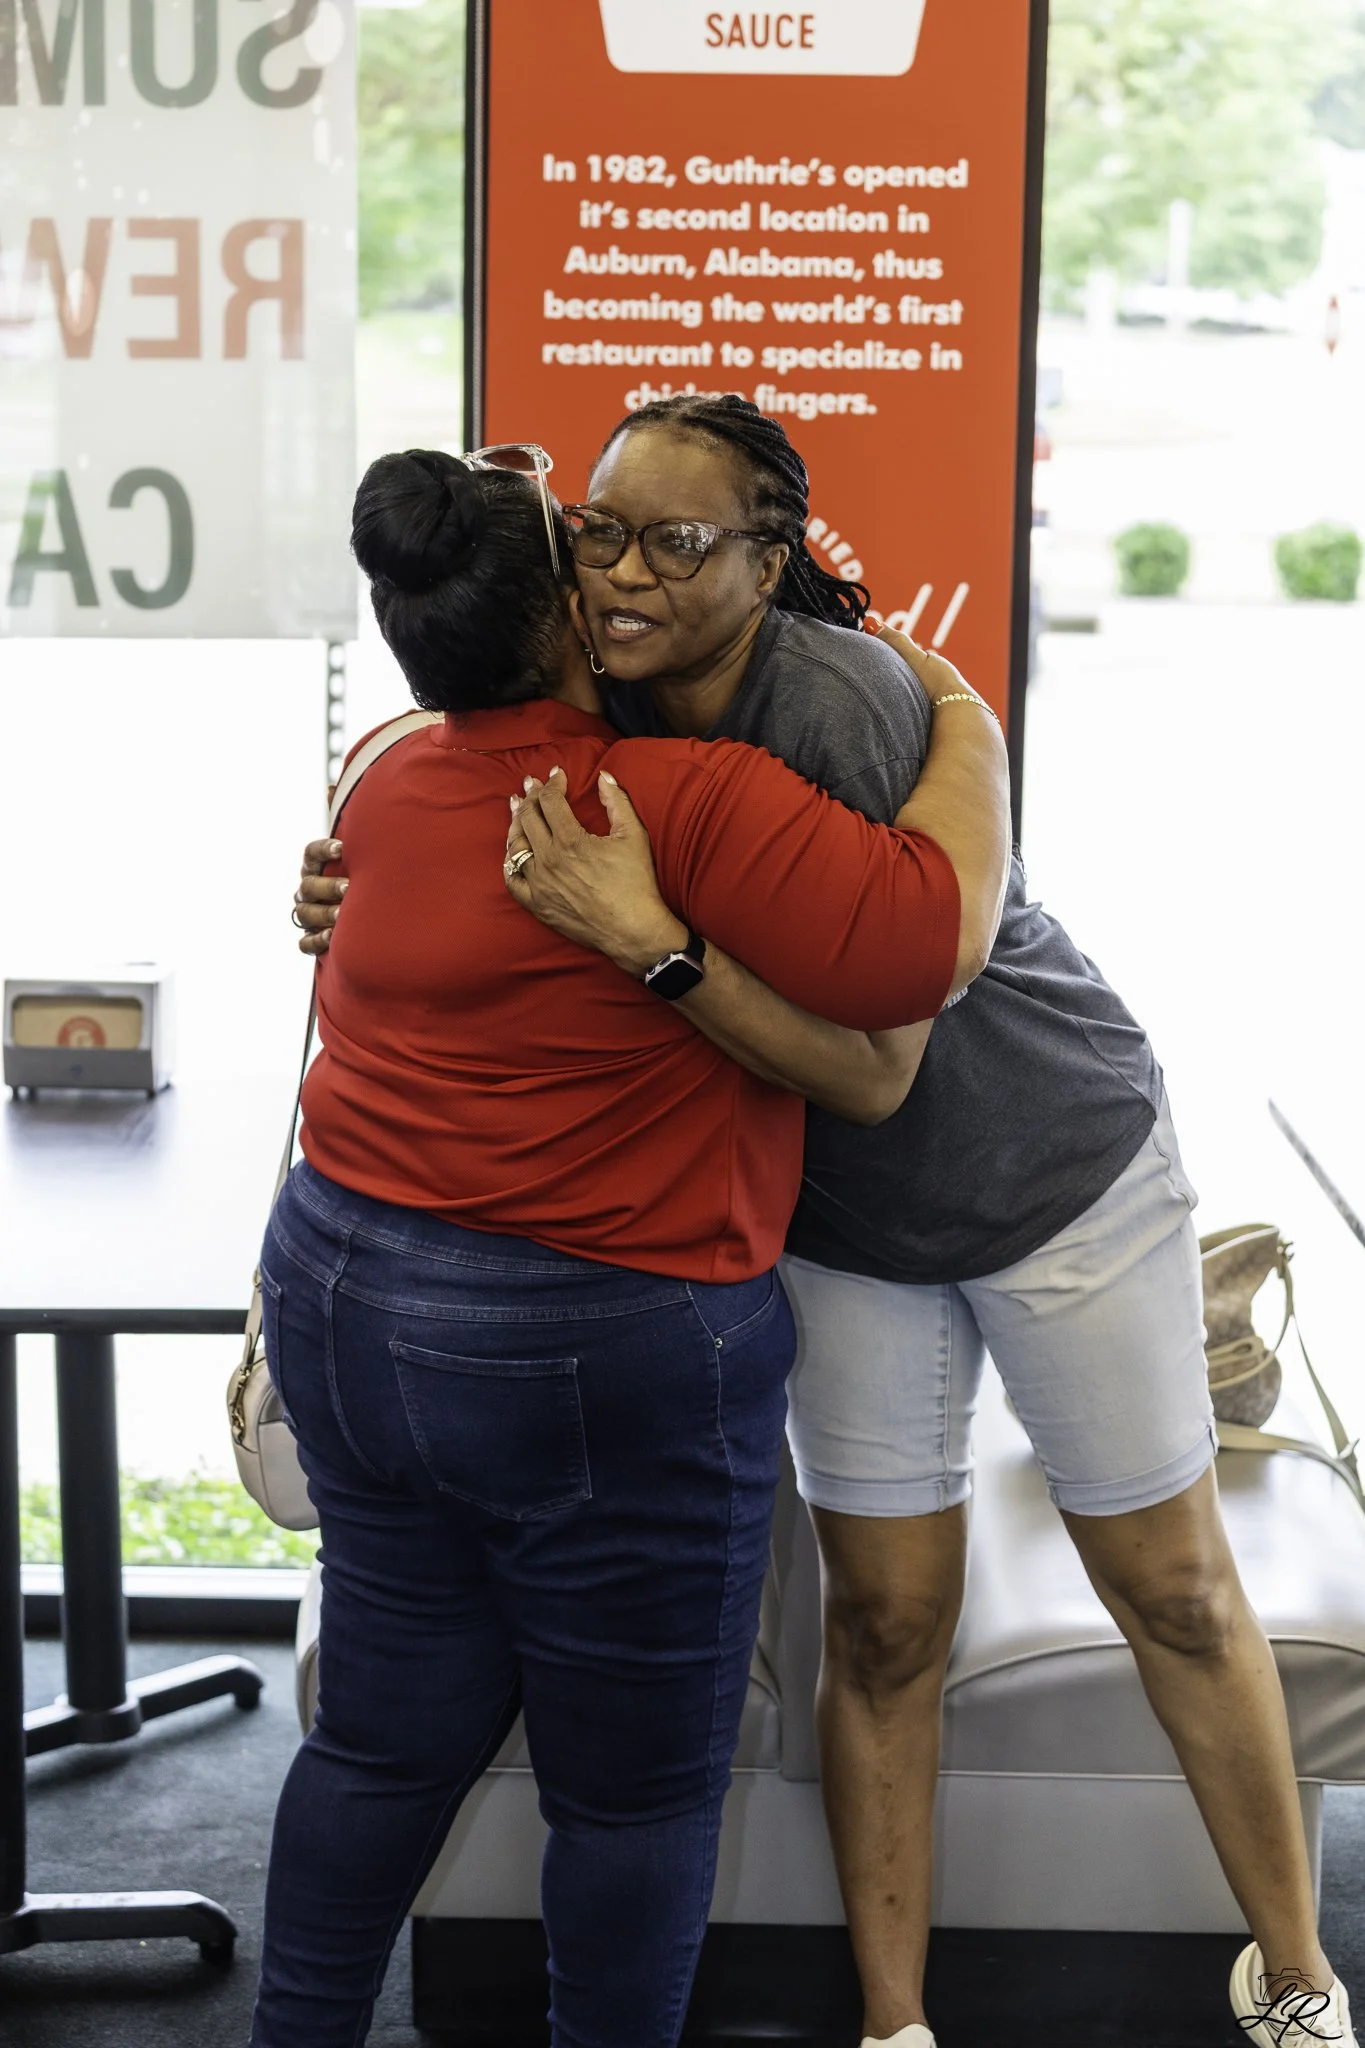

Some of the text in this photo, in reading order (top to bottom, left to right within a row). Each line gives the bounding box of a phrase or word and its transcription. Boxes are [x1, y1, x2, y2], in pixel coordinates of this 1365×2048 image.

[706, 12, 815, 49] SAUCE
[543, 153, 969, 193] In 1982, Guthrie's opened
[580, 200, 930, 233] it's second location in
[563, 245, 944, 282] Auburn, Alabama, thus
[543, 289, 964, 328] becoming the world's first
[542, 340, 963, 375] restaurant to specialize in
[753, 383, 878, 421] fingers.
[806, 516, 865, 581] RIED
